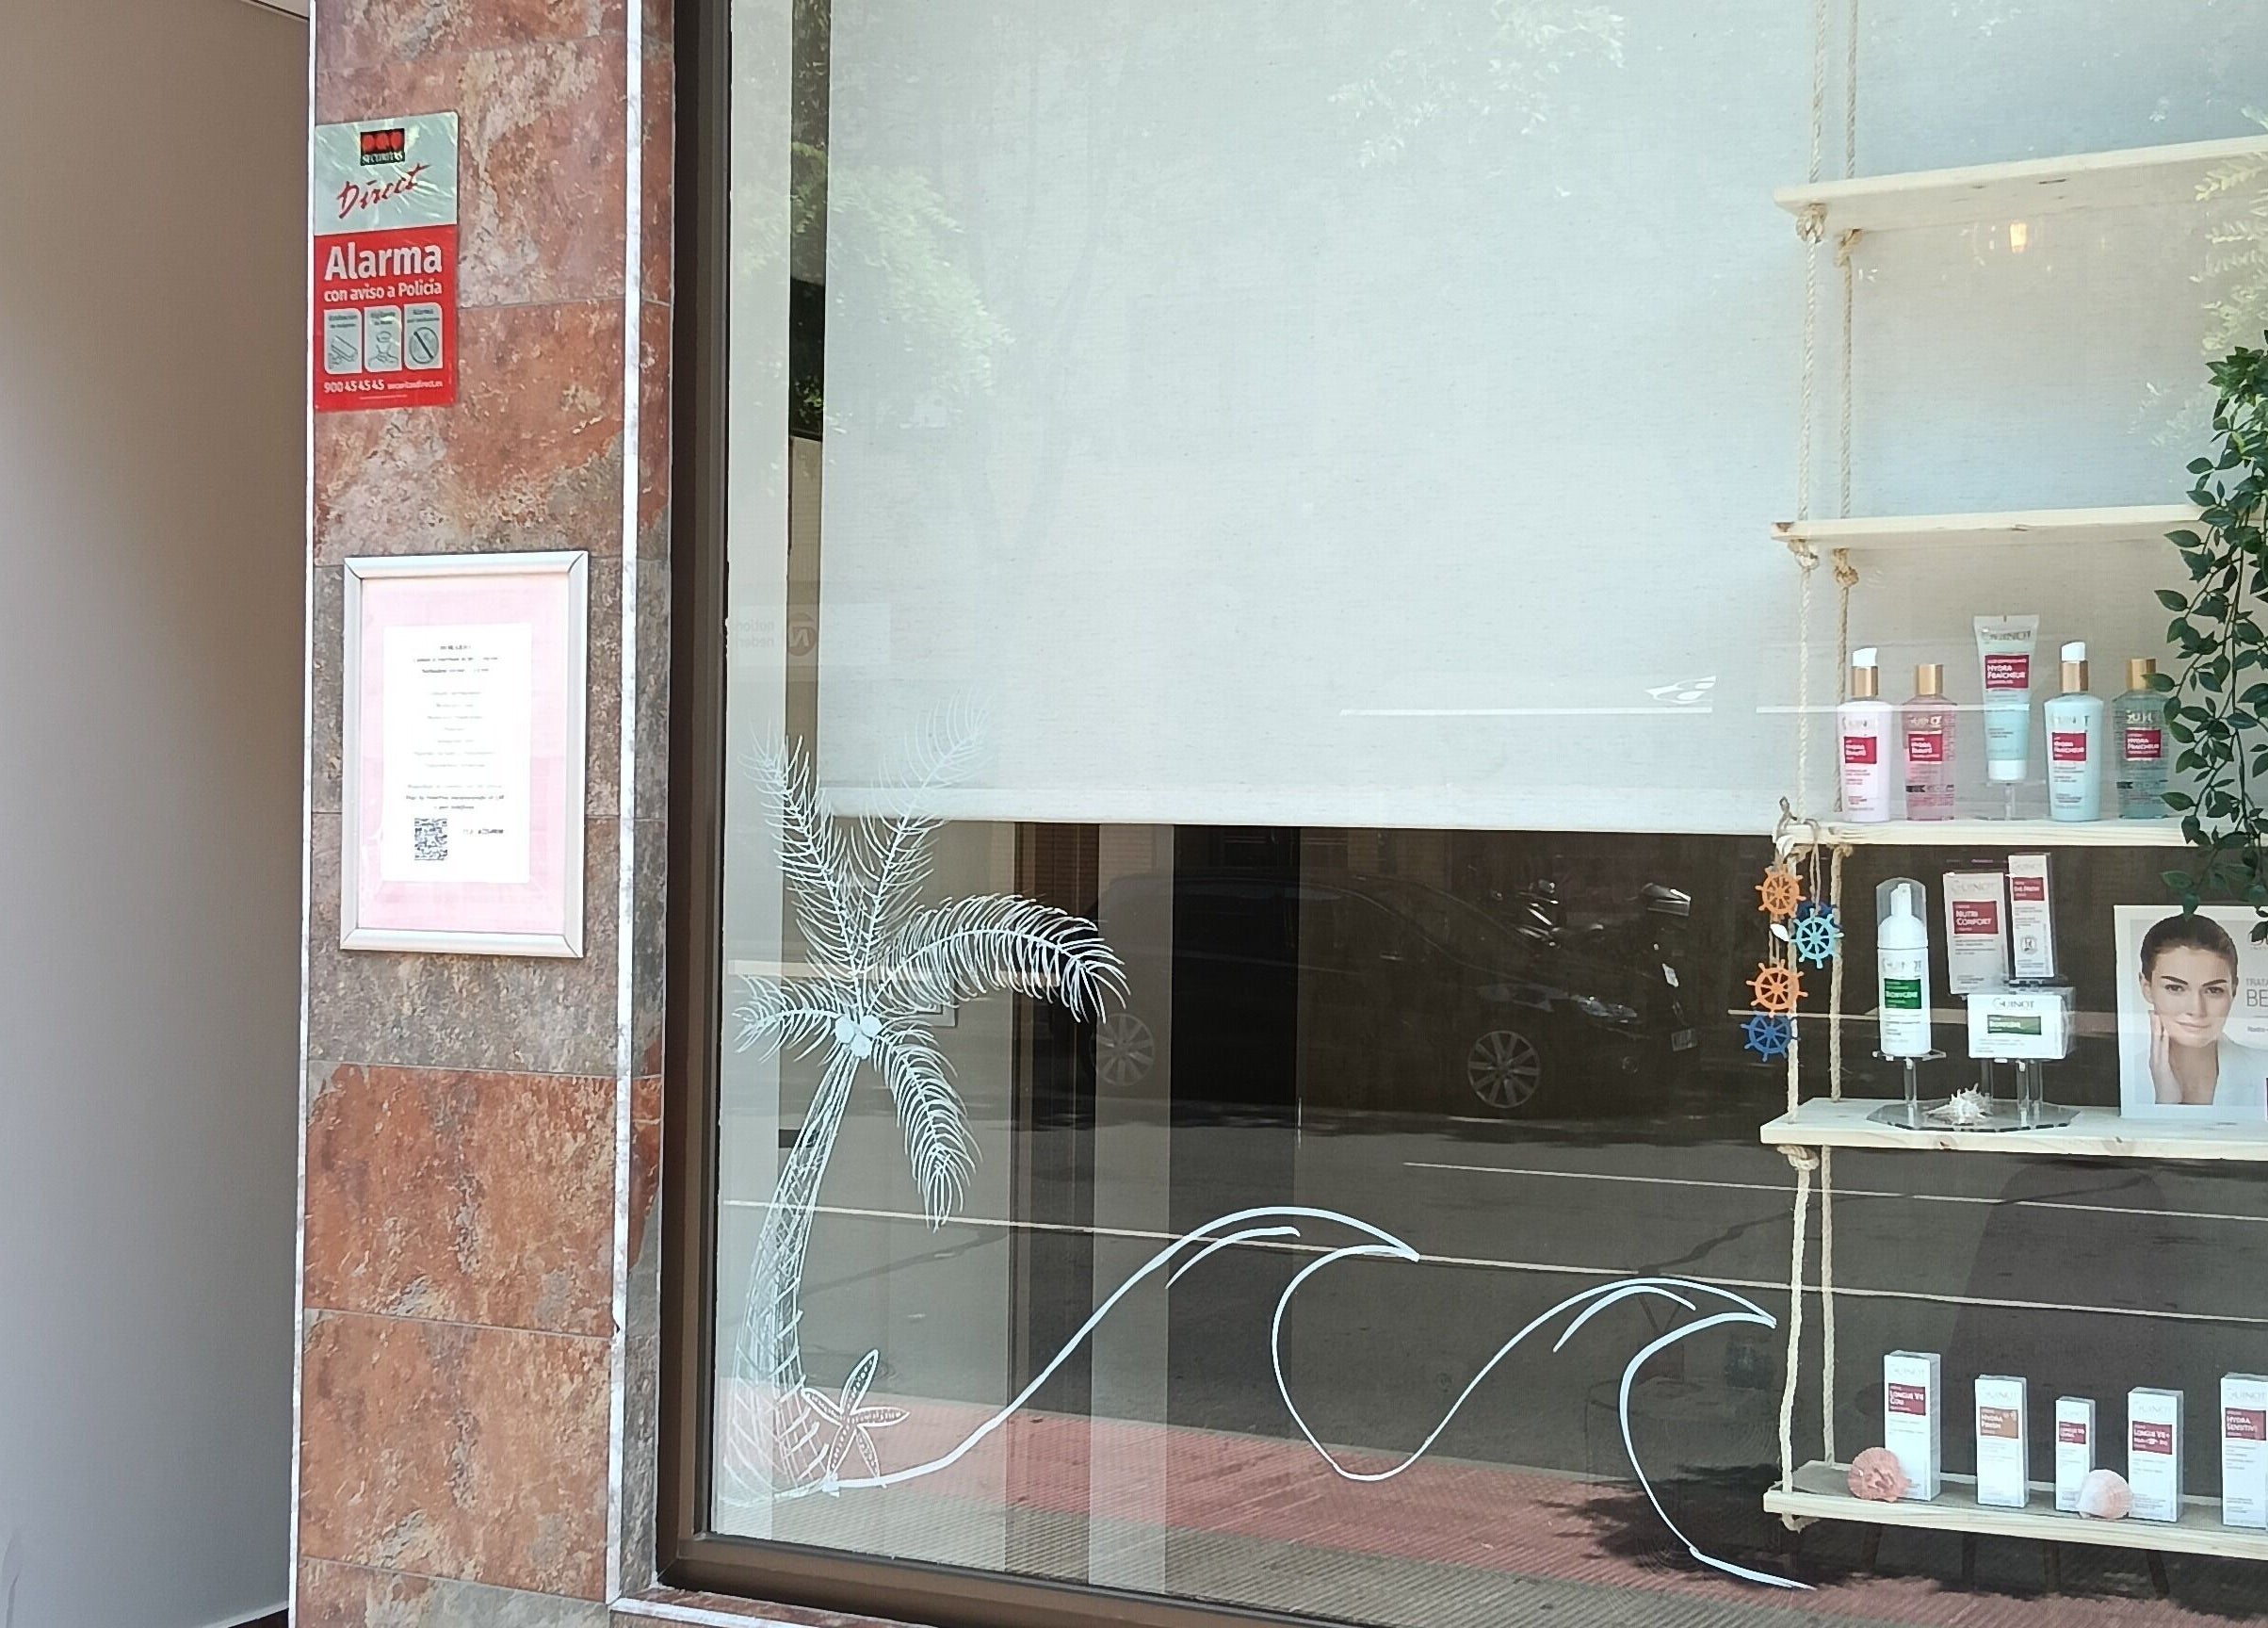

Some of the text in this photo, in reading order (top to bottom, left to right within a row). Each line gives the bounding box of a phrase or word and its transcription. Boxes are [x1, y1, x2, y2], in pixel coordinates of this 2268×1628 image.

[336, 163, 431, 219] Direct
[324, 241, 443, 281] Alarma
[324, 288, 348, 301] con
[349, 284, 384, 301] aviso
[386, 285, 396, 298] a
